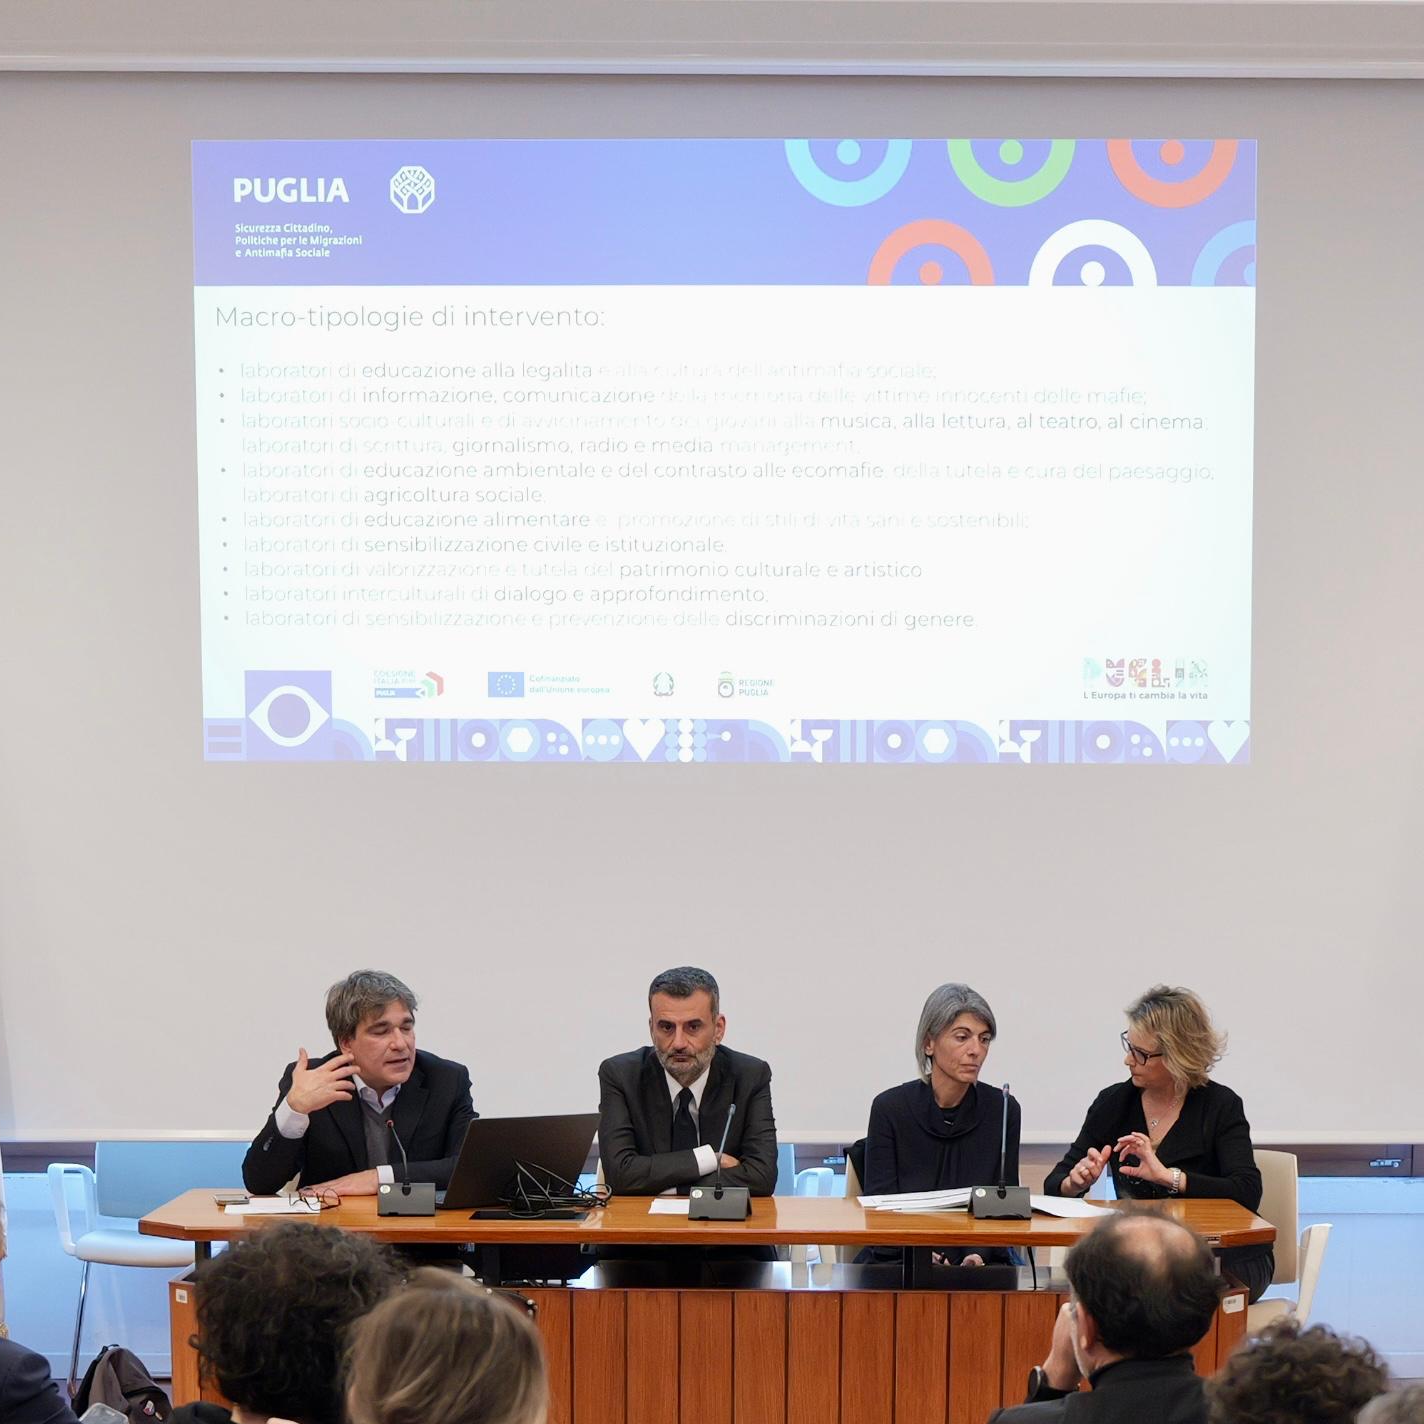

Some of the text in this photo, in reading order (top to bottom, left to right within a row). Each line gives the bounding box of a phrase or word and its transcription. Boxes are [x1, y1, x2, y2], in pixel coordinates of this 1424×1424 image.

[234, 178, 349, 203] PUGLIA
[235, 223, 333, 235] Sicurezza Cittadino,
[235, 235, 279, 246] Politiche
[281, 238, 297, 247] per
[310, 235, 363, 247] Migrazioni
[235, 247, 331, 259] e Antimafia Sociale
[214, 304, 606, 333] Macro-tipologie di intervento:
[361, 361, 477, 379] educazione
[481, 361, 515, 379] alla
[503, 386, 656, 403] comunicazione
[820, 411, 897, 431] musica,
[902, 411, 935, 429] alla
[941, 411, 1011, 431] lettura,
[1015, 411, 1033, 429] al
[1039, 411, 1102, 431] teatro,
[1106, 411, 1123, 429] al
[451, 436, 573, 457] giornalismo,
[579, 436, 629, 453] radio
[633, 439, 646, 453] e
[651, 436, 714, 453] media
[363, 461, 478, 479] educazione
[482, 461, 596, 479] ambientale
[600, 464, 613, 479] e
[618, 461, 649, 479] del
[653, 461, 748, 479] contrasto
[752, 461, 787, 479] alle
[363, 486, 470, 507] agricoltura
[363, 511, 478, 528] educazione
[482, 511, 591, 528] alimentare
[363, 536, 529, 553] sensibilizzazione
[532, 536, 584, 553] civile
[587, 539, 601, 553] e
[619, 561, 729, 582] patrimonio
[734, 561, 821, 578] culturale
[826, 564, 839, 578] e
[493, 585, 568, 607] dialogo
[573, 588, 586, 603] e
[725, 610, 875, 627] discriminazioni
[879, 610, 898, 627] di
[738, 679, 774, 687] REGIONE
[738, 688, 769, 697] PUGLIA
[1129, 691, 1137, 700] ti
[1139, 691, 1176, 700] cambia
[1178, 691, 1187, 700] la
[1189, 691, 1209, 700] vita
